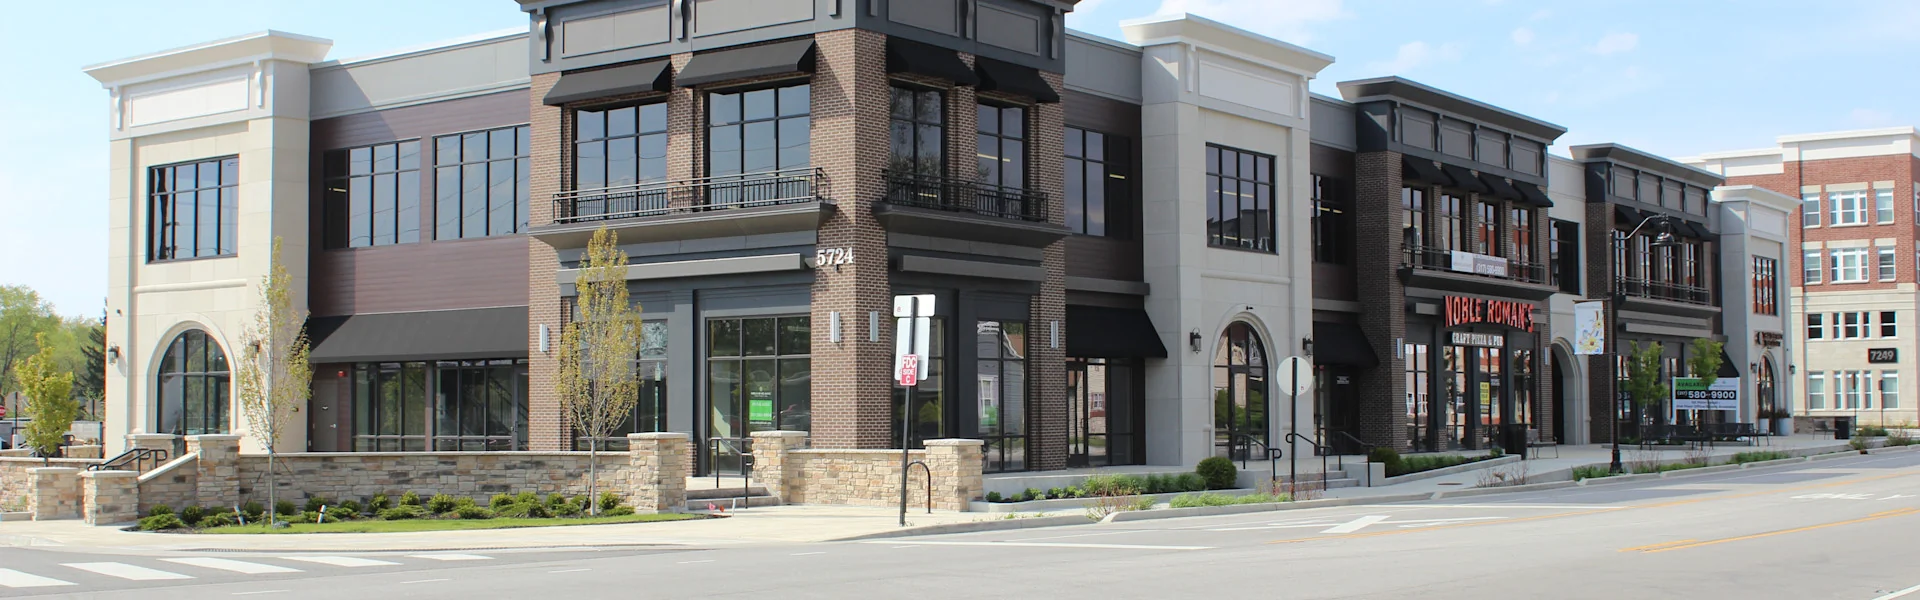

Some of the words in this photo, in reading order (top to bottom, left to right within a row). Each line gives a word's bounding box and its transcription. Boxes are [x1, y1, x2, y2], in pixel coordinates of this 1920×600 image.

[817, 247, 854, 265] 5724
[1445, 295, 1482, 328] NOBLE
[1487, 299, 1534, 333] ROMAN'S
[1452, 332, 1470, 344] CRAFT
[1471, 333, 1487, 345] PIZZA
[1493, 335, 1504, 347] PUB
[1870, 350, 1894, 360] 7249
[902, 357, 917, 368] FDC
[906, 375, 911, 383] C
